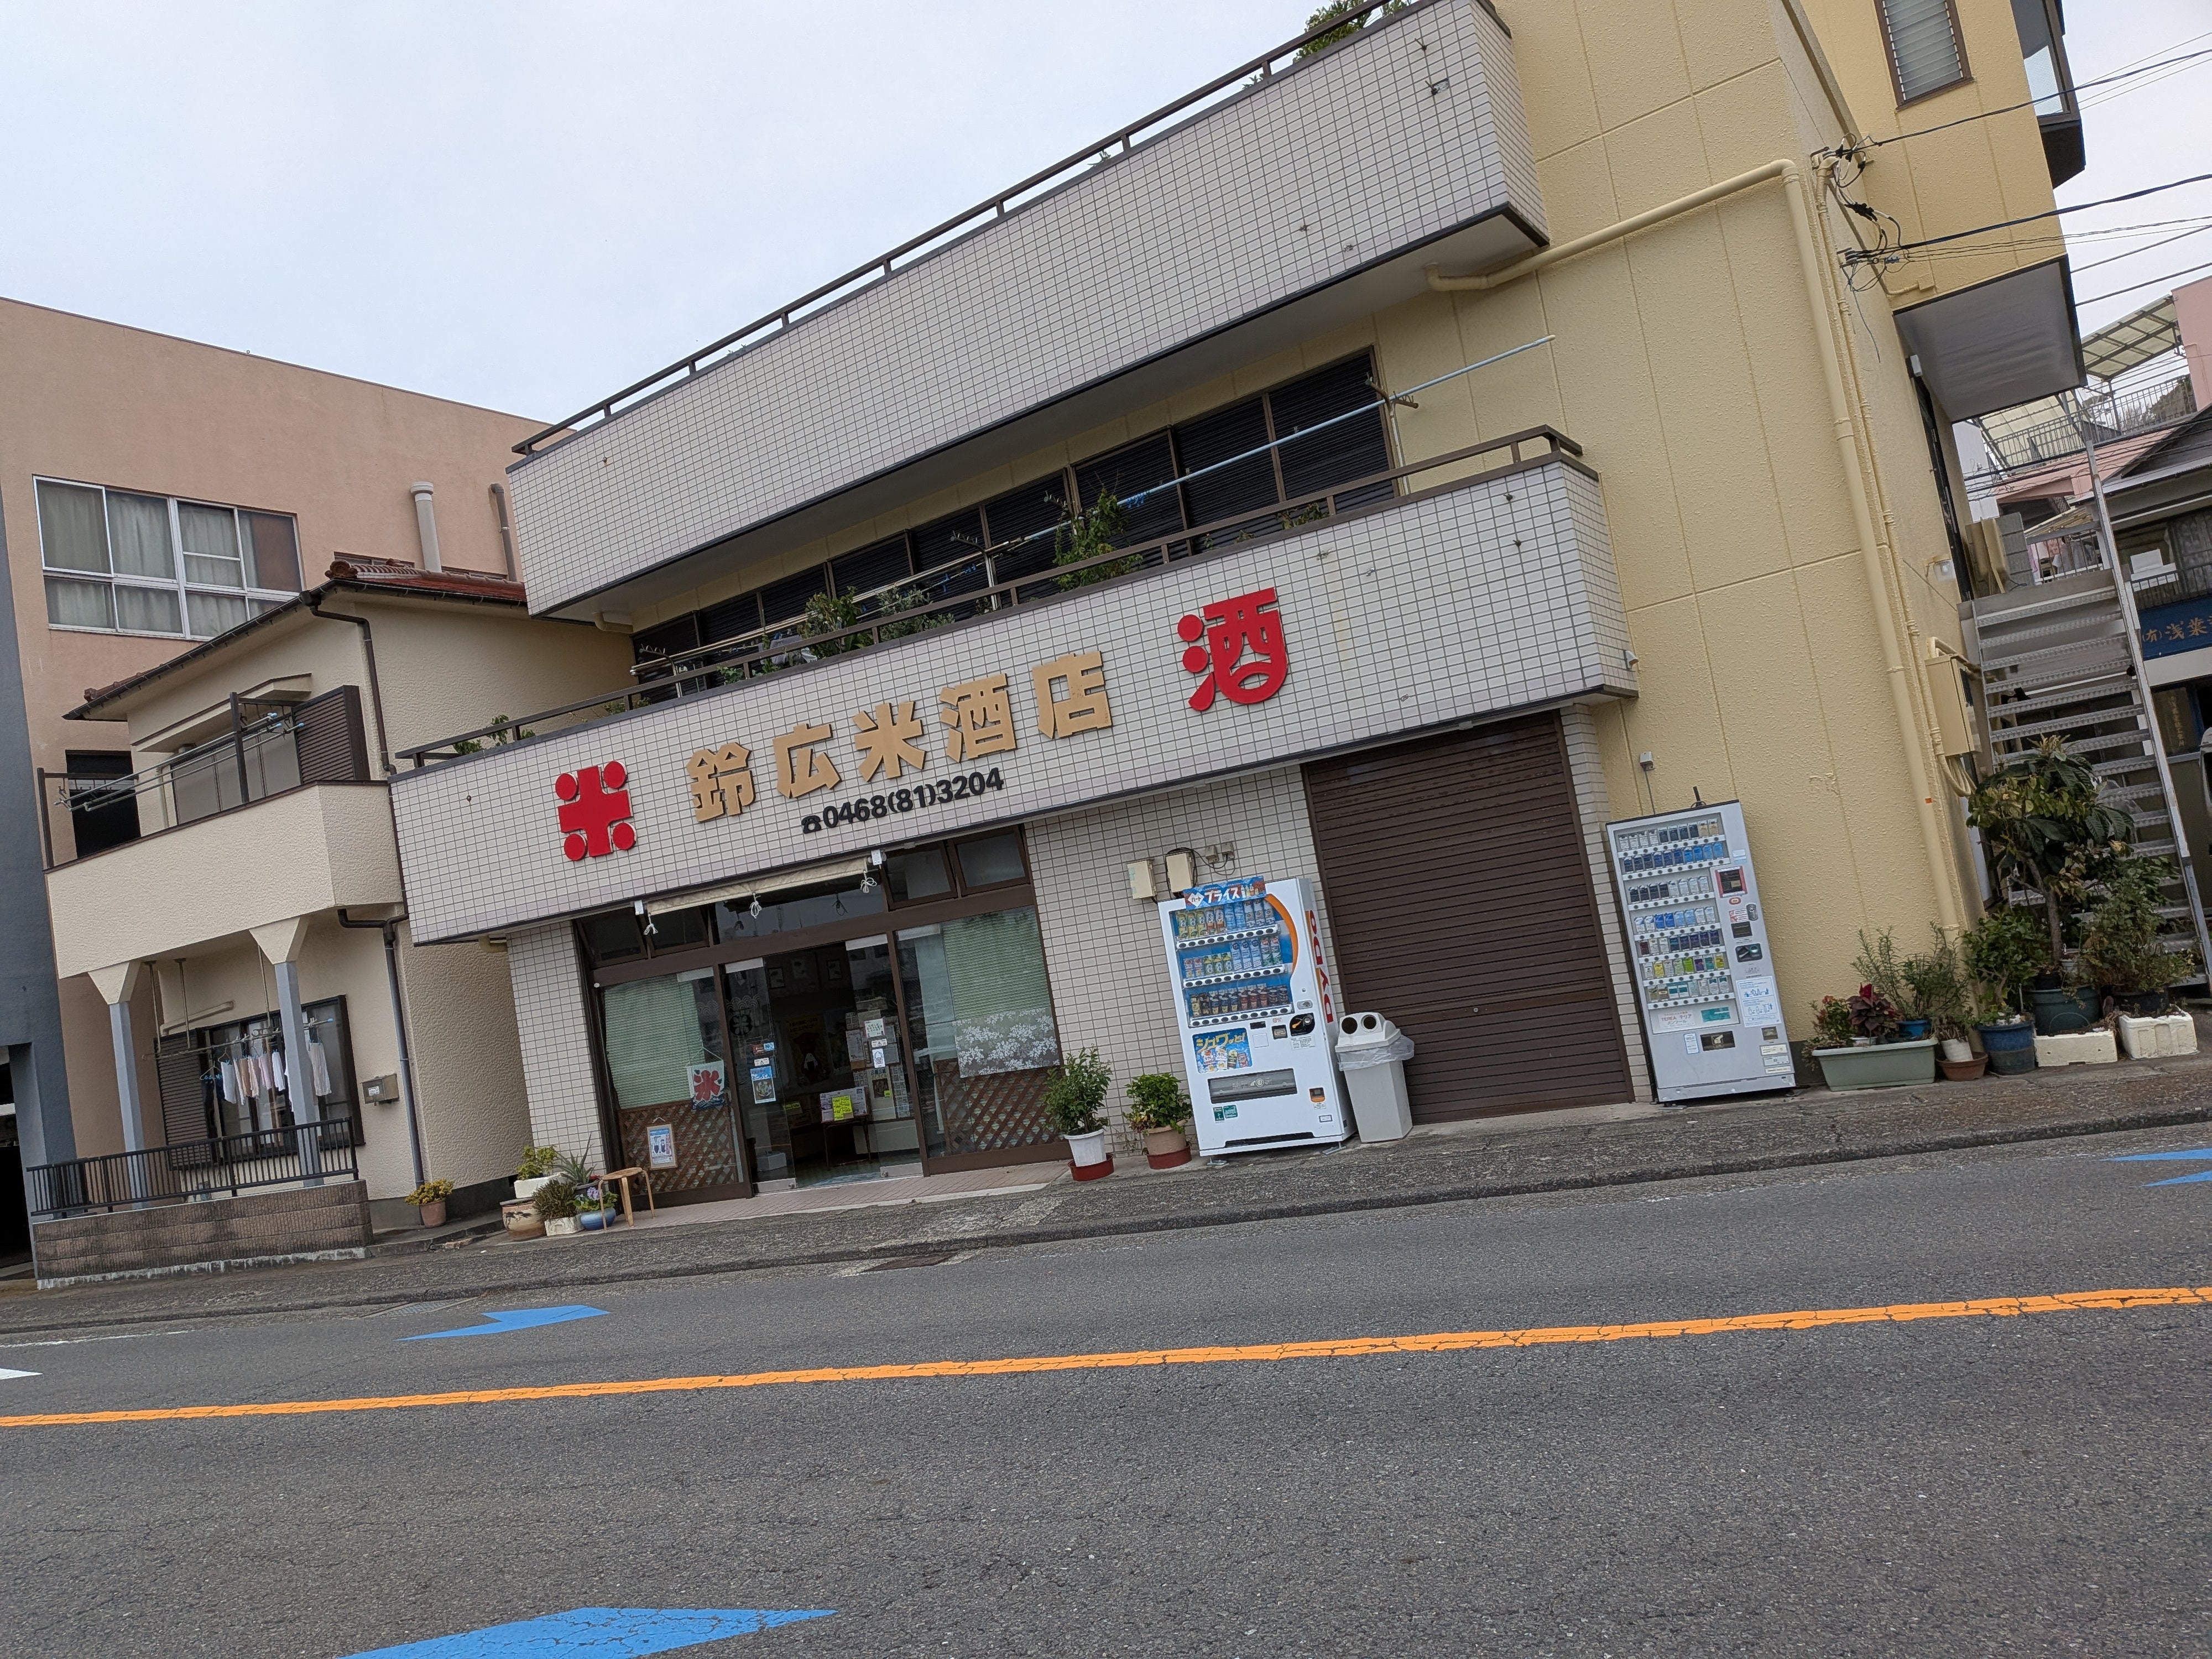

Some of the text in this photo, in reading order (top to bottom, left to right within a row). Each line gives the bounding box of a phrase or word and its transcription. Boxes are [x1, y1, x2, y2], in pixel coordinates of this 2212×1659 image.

[1177, 587, 1288, 711] 酒
[685, 650, 1113, 823] 鈴広米酒店
[822, 768, 1004, 828] 0468(81)3204
[1204, 888, 1240, 904] プライス
[693, 1070, 721, 1101] 氷
